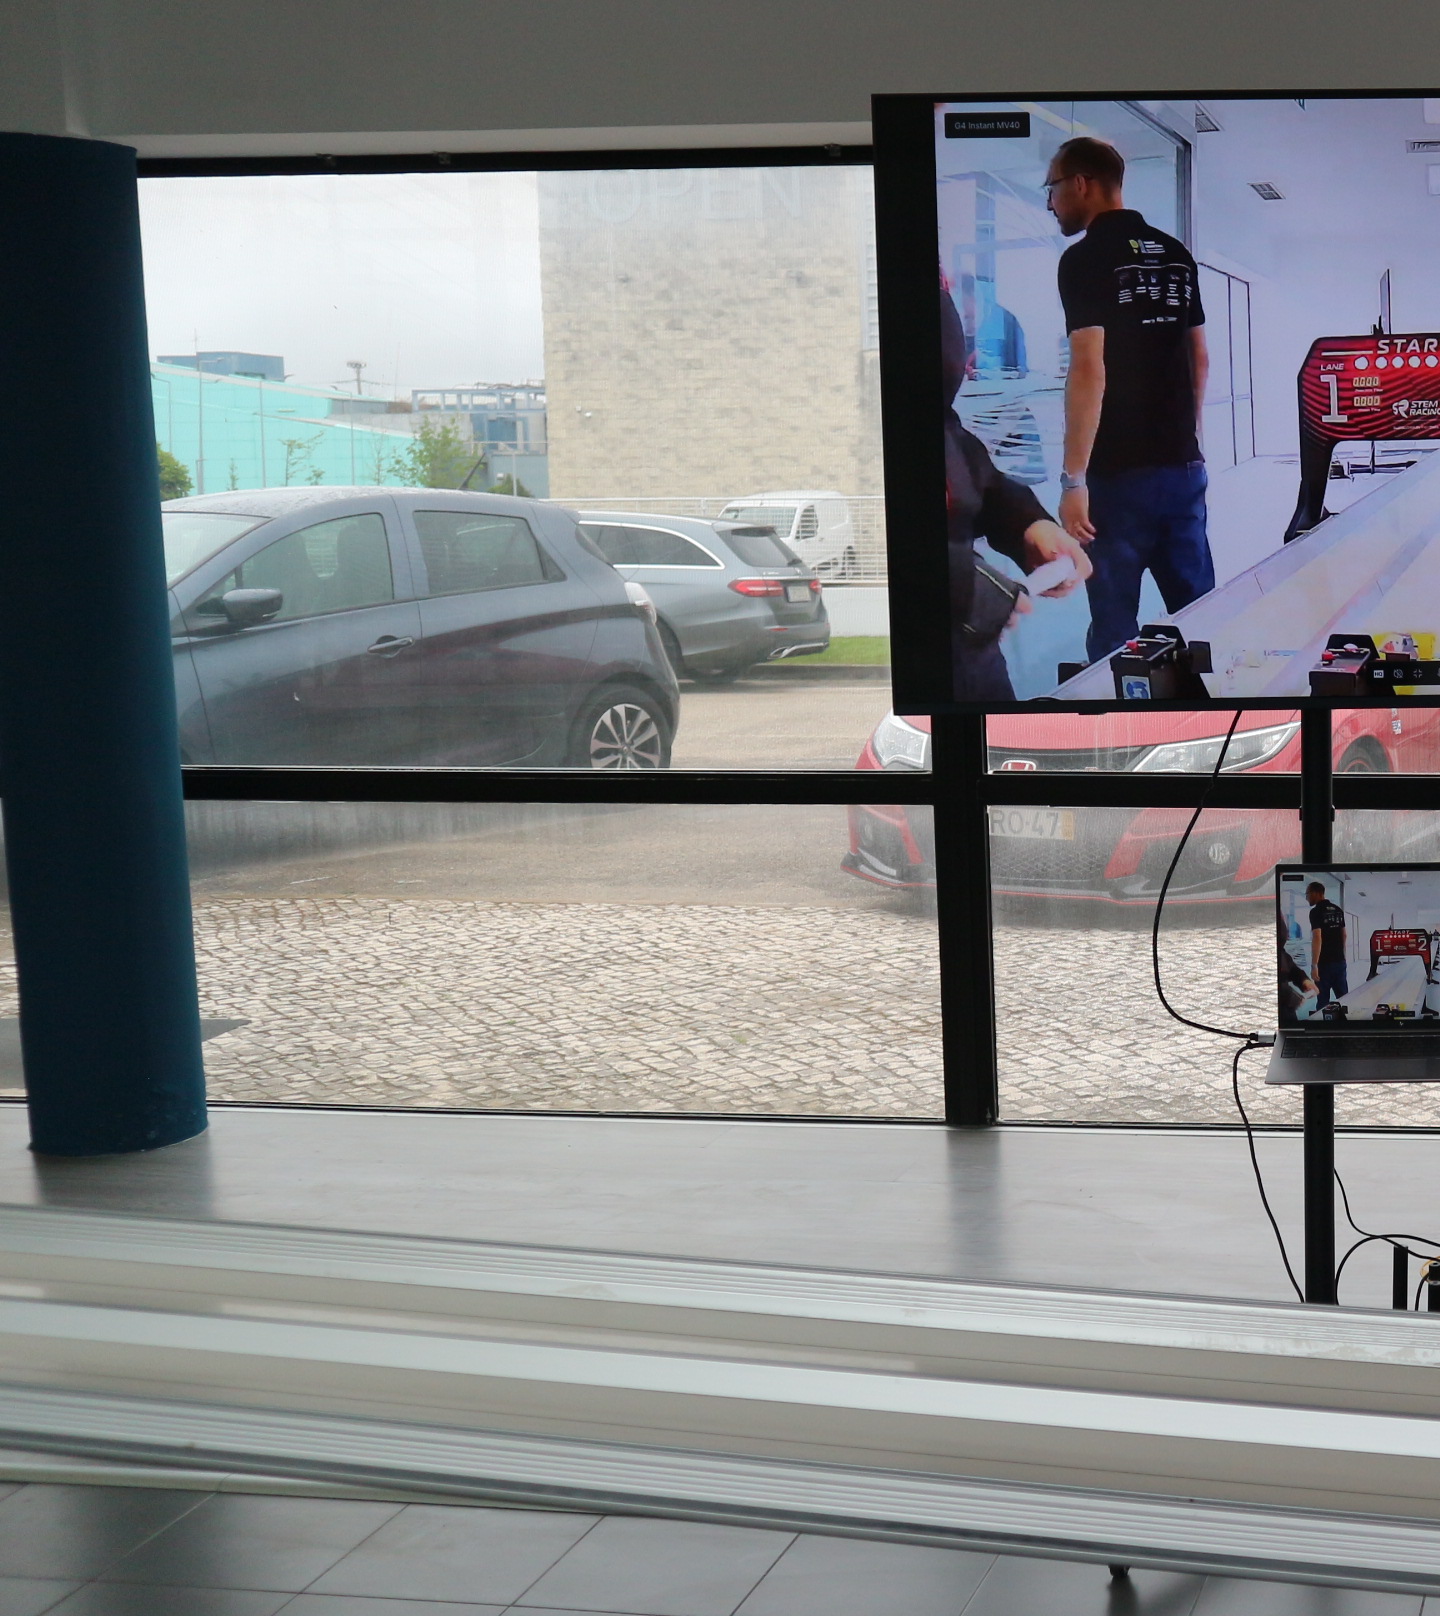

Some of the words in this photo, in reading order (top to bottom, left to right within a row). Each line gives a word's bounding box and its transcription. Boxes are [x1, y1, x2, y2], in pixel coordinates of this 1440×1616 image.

[954, 122, 966, 130] G4
[968, 121, 995, 129] Instant
[996, 121, 1020, 129] MV40
[1320, 363, 1345, 371] LANE
[1320, 374, 1348, 423] 1
[1410, 400, 1439, 408] STEM
[1418, 938, 1427, 951] 2
